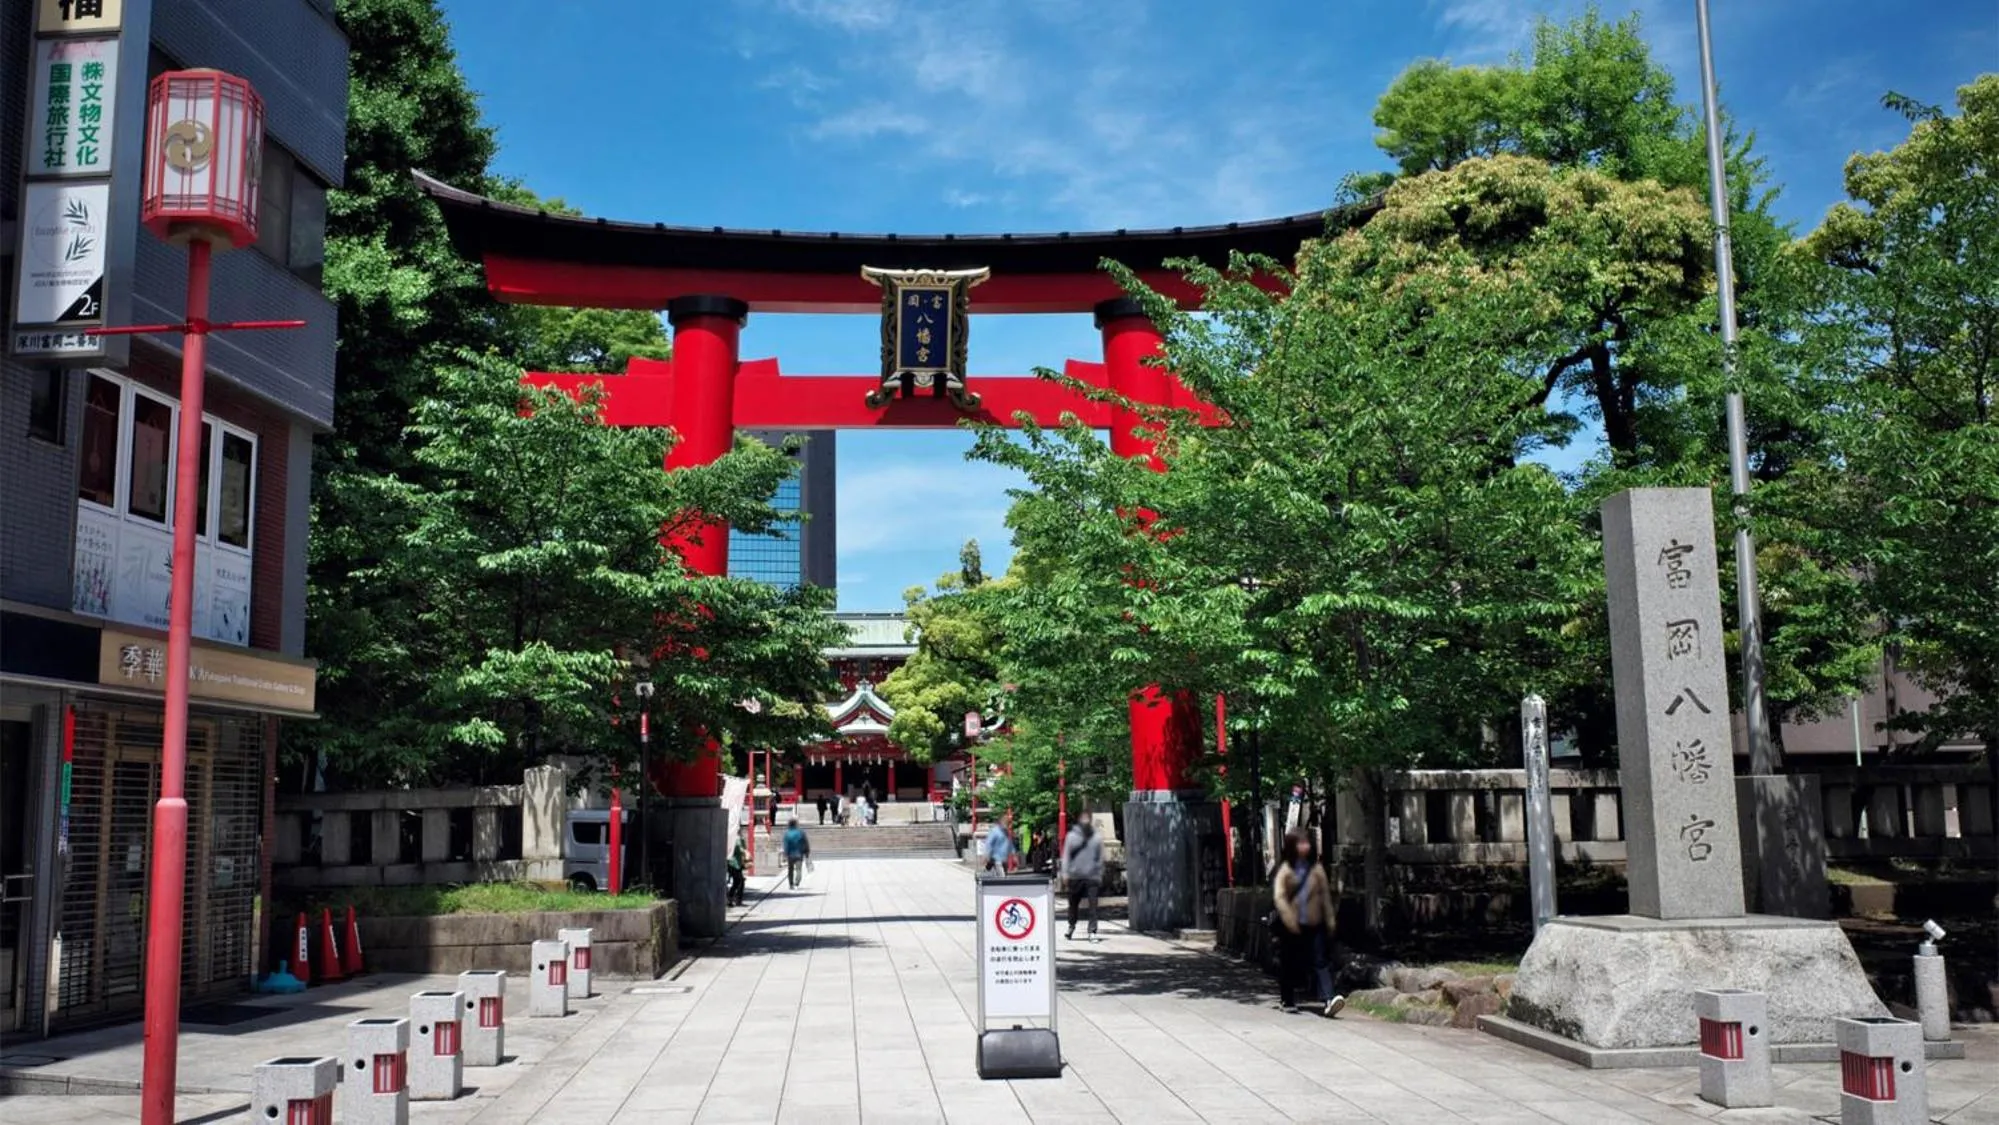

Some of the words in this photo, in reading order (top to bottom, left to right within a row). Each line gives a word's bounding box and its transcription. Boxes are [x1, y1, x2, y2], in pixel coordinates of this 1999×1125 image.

[44, 63, 73, 169] 国際旅行社
[78, 294, 99, 316] 2F
[1657, 538, 1714, 862] 富岡八幡宮
